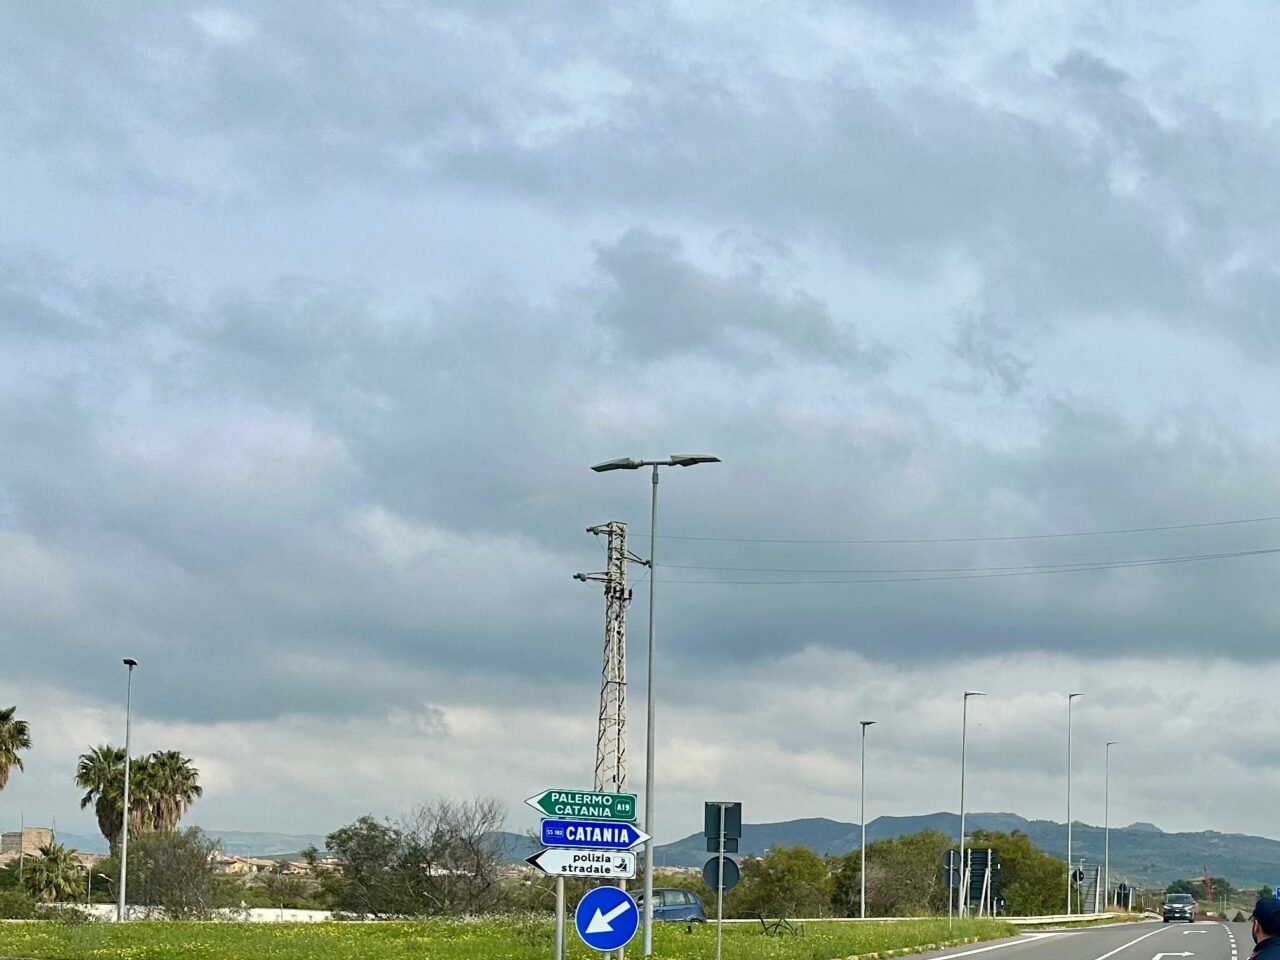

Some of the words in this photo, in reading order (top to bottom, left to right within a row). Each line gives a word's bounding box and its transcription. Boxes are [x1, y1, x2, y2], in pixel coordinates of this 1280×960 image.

[551, 792, 612, 806] PALERMO
[555, 804, 612, 817] CATANIA
[616, 803, 630, 811] A19
[566, 826, 630, 843] CATANIA
[573, 853, 611, 863] polizia
[561, 863, 611, 874] stradale
